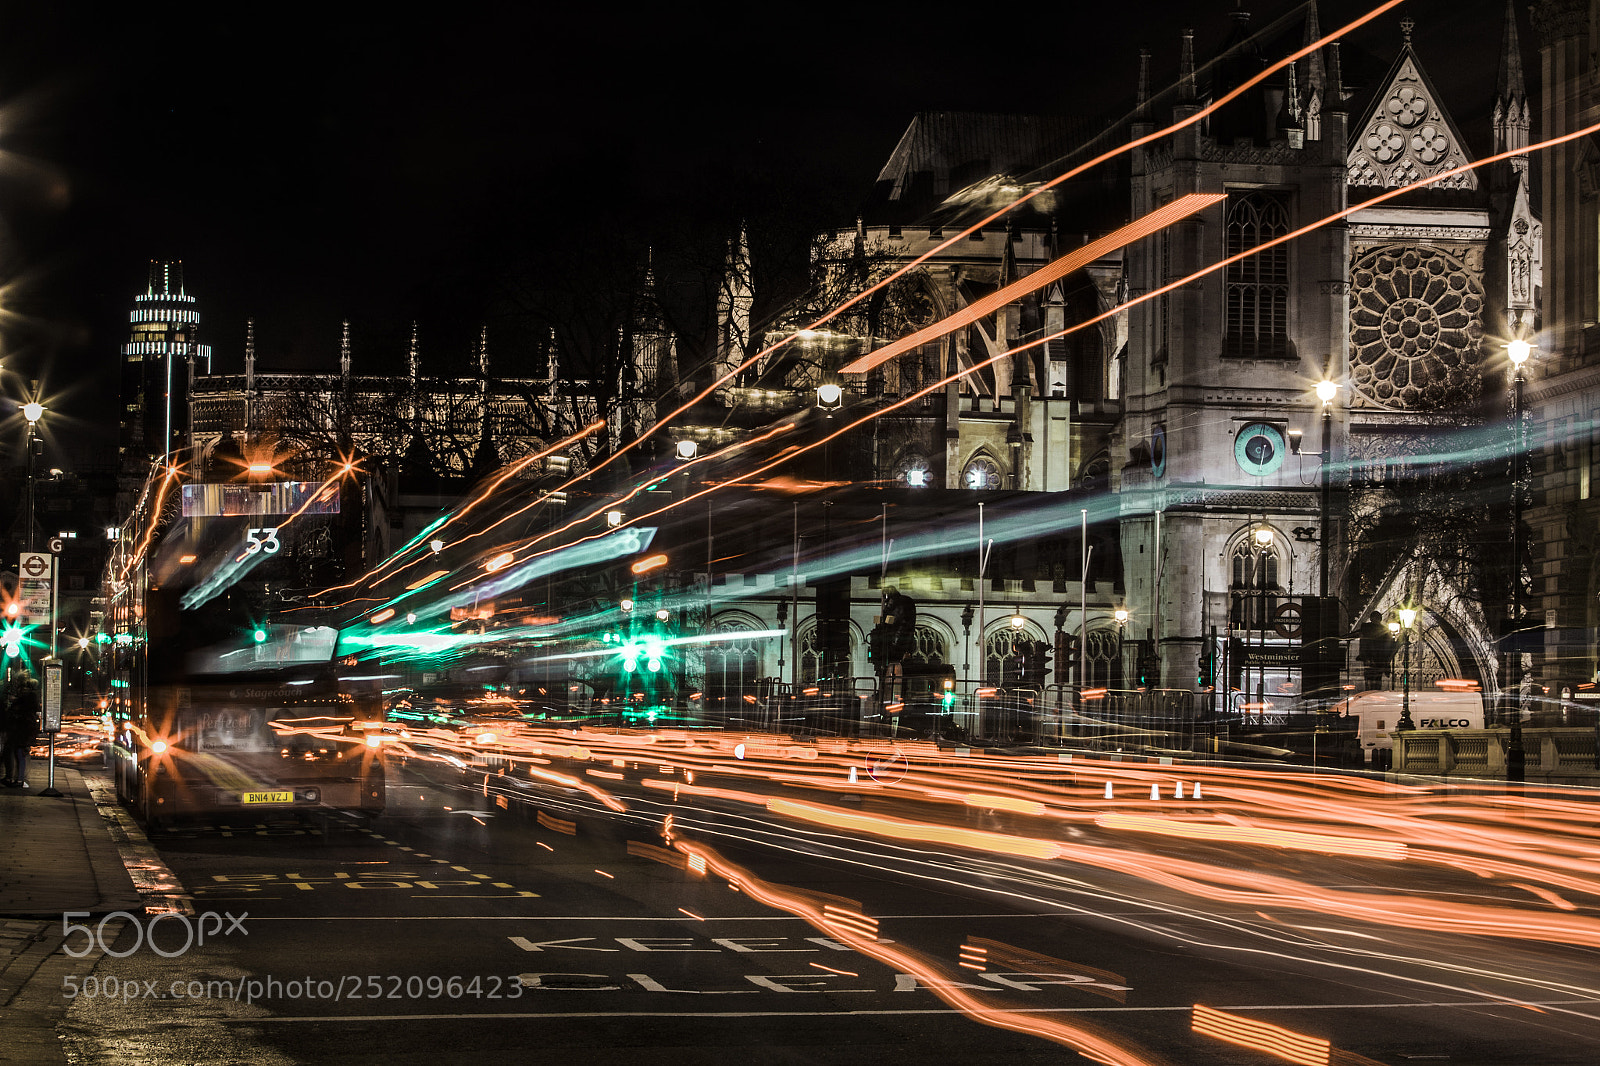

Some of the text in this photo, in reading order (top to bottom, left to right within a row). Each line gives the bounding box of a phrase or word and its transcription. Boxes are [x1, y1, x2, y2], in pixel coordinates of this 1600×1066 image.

[51, 539, 62, 552] G
[246, 528, 280, 553] 53
[1248, 653, 1300, 661] Westminster
[1420, 719, 1470, 728] FALCO
[212, 872, 420, 882] BUS
